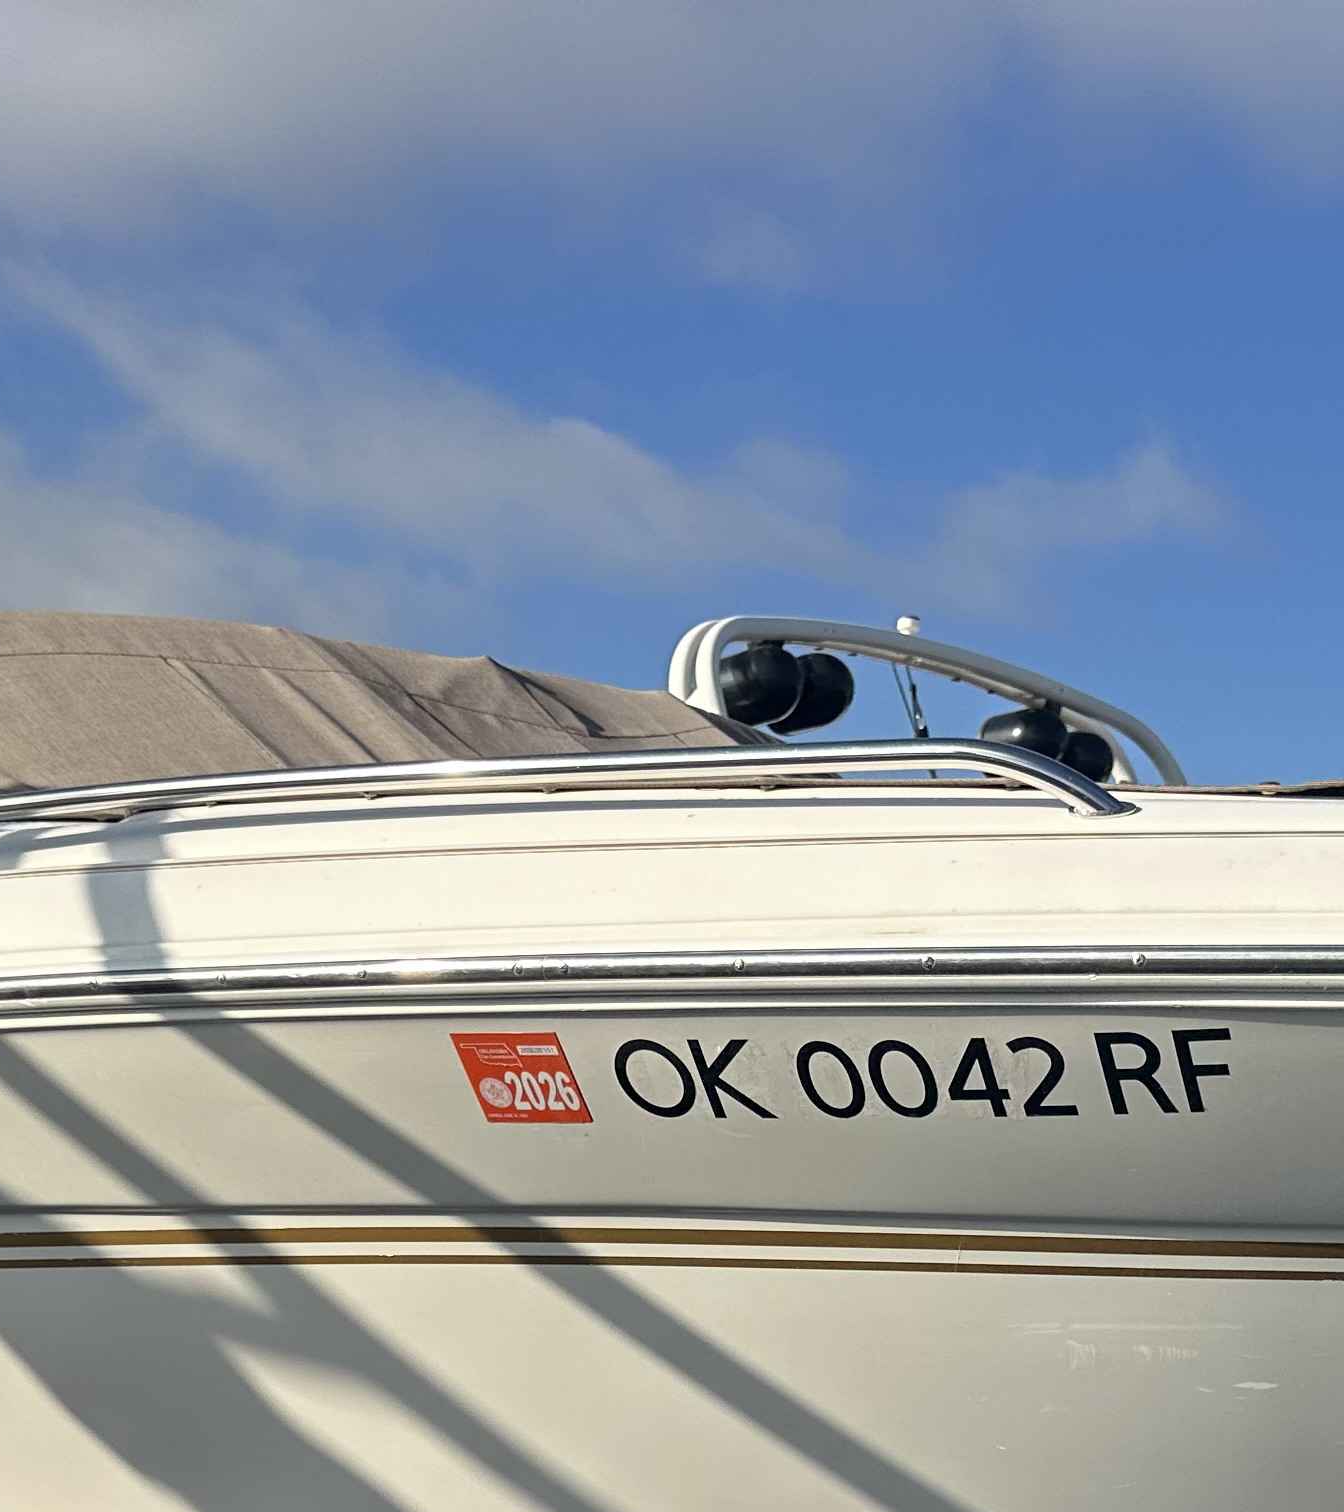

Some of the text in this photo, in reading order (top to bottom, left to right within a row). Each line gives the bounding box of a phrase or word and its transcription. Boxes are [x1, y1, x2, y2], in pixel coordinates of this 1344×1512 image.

[503, 1070, 581, 1111] 2026
[614, 1027, 1232, 1119] OK 0042 RF
